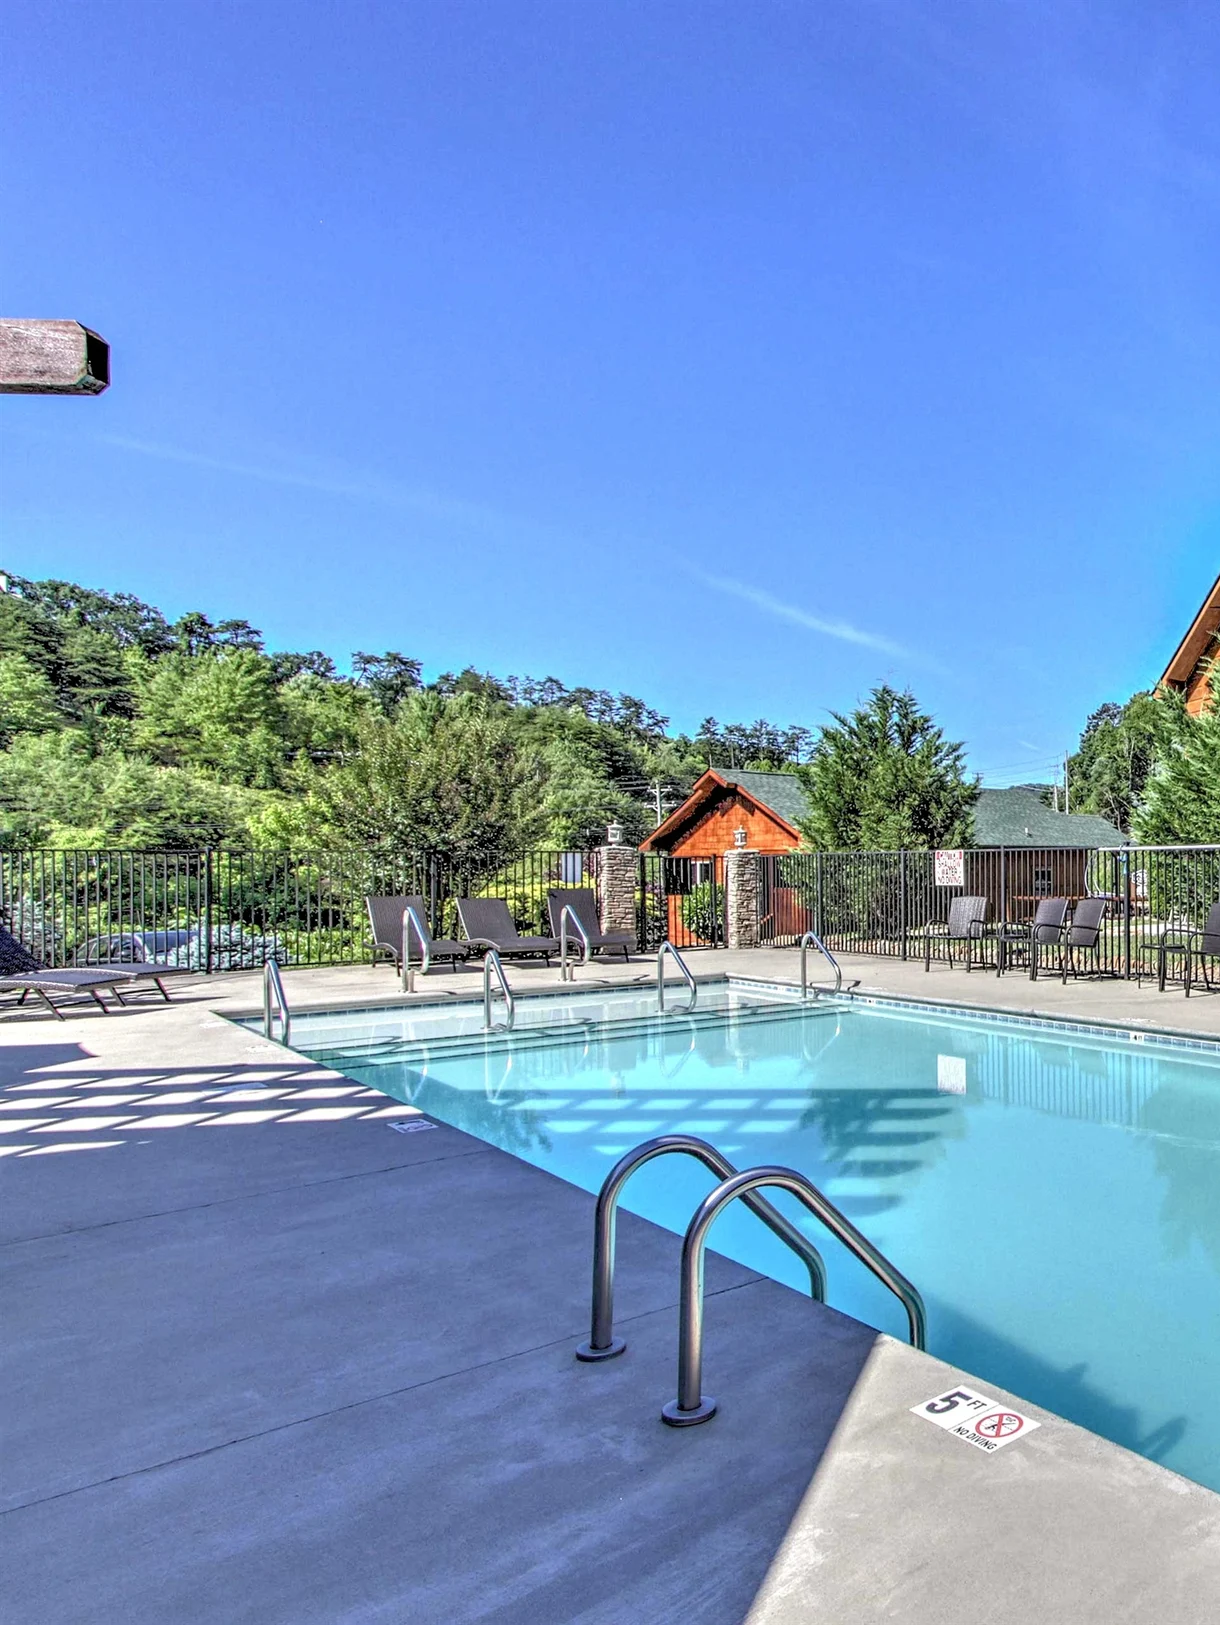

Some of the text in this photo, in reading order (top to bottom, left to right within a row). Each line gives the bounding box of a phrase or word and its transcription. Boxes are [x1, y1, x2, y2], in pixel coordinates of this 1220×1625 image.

[925, 1391, 987, 1414] 5 FT
[953, 1426, 998, 1450] NO DIVING
